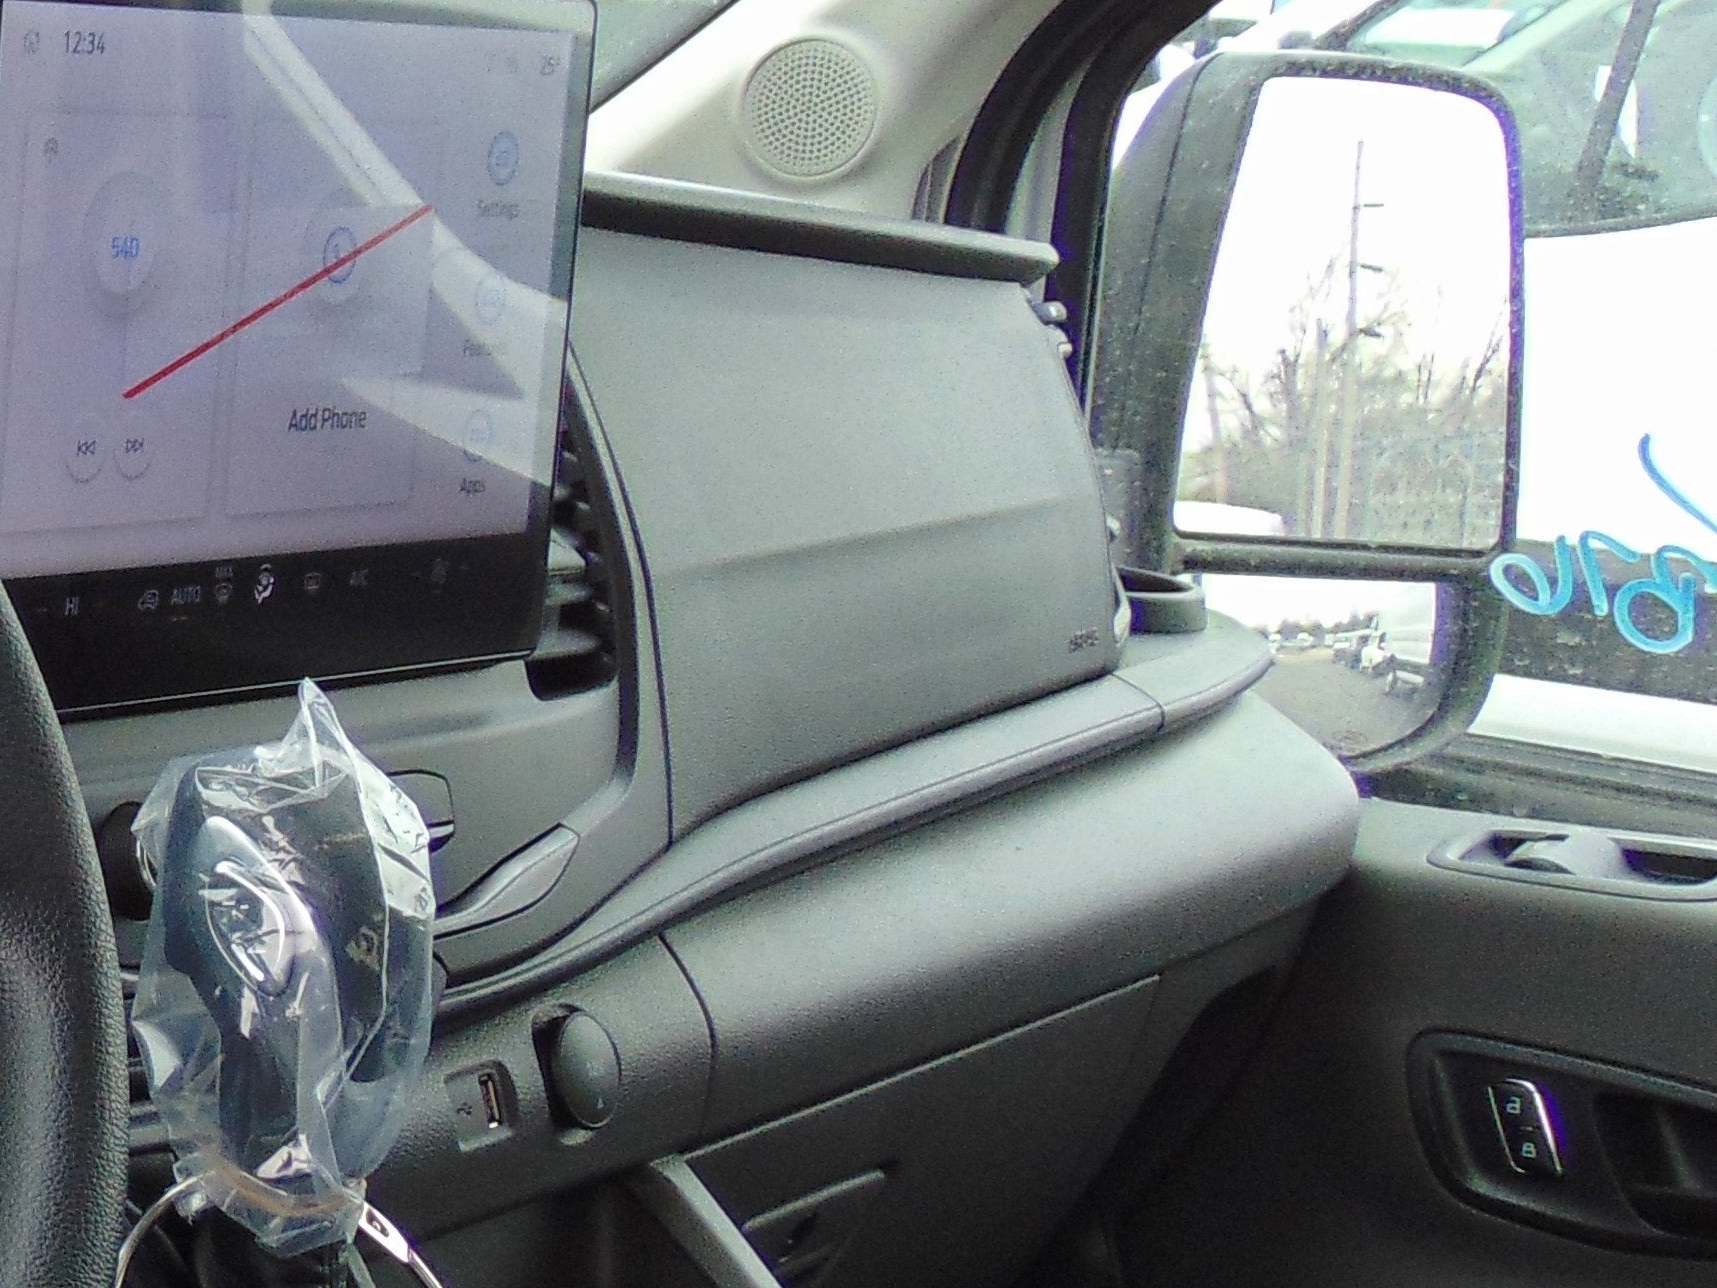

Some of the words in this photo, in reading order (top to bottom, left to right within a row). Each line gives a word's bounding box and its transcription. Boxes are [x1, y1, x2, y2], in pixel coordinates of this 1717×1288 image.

[64, 30, 107, 55] 12:34
[288, 409, 318, 432] Add
[321, 406, 367, 431] Phone
[65, 596, 79, 616] HI
[171, 585, 202, 606] AUTO
